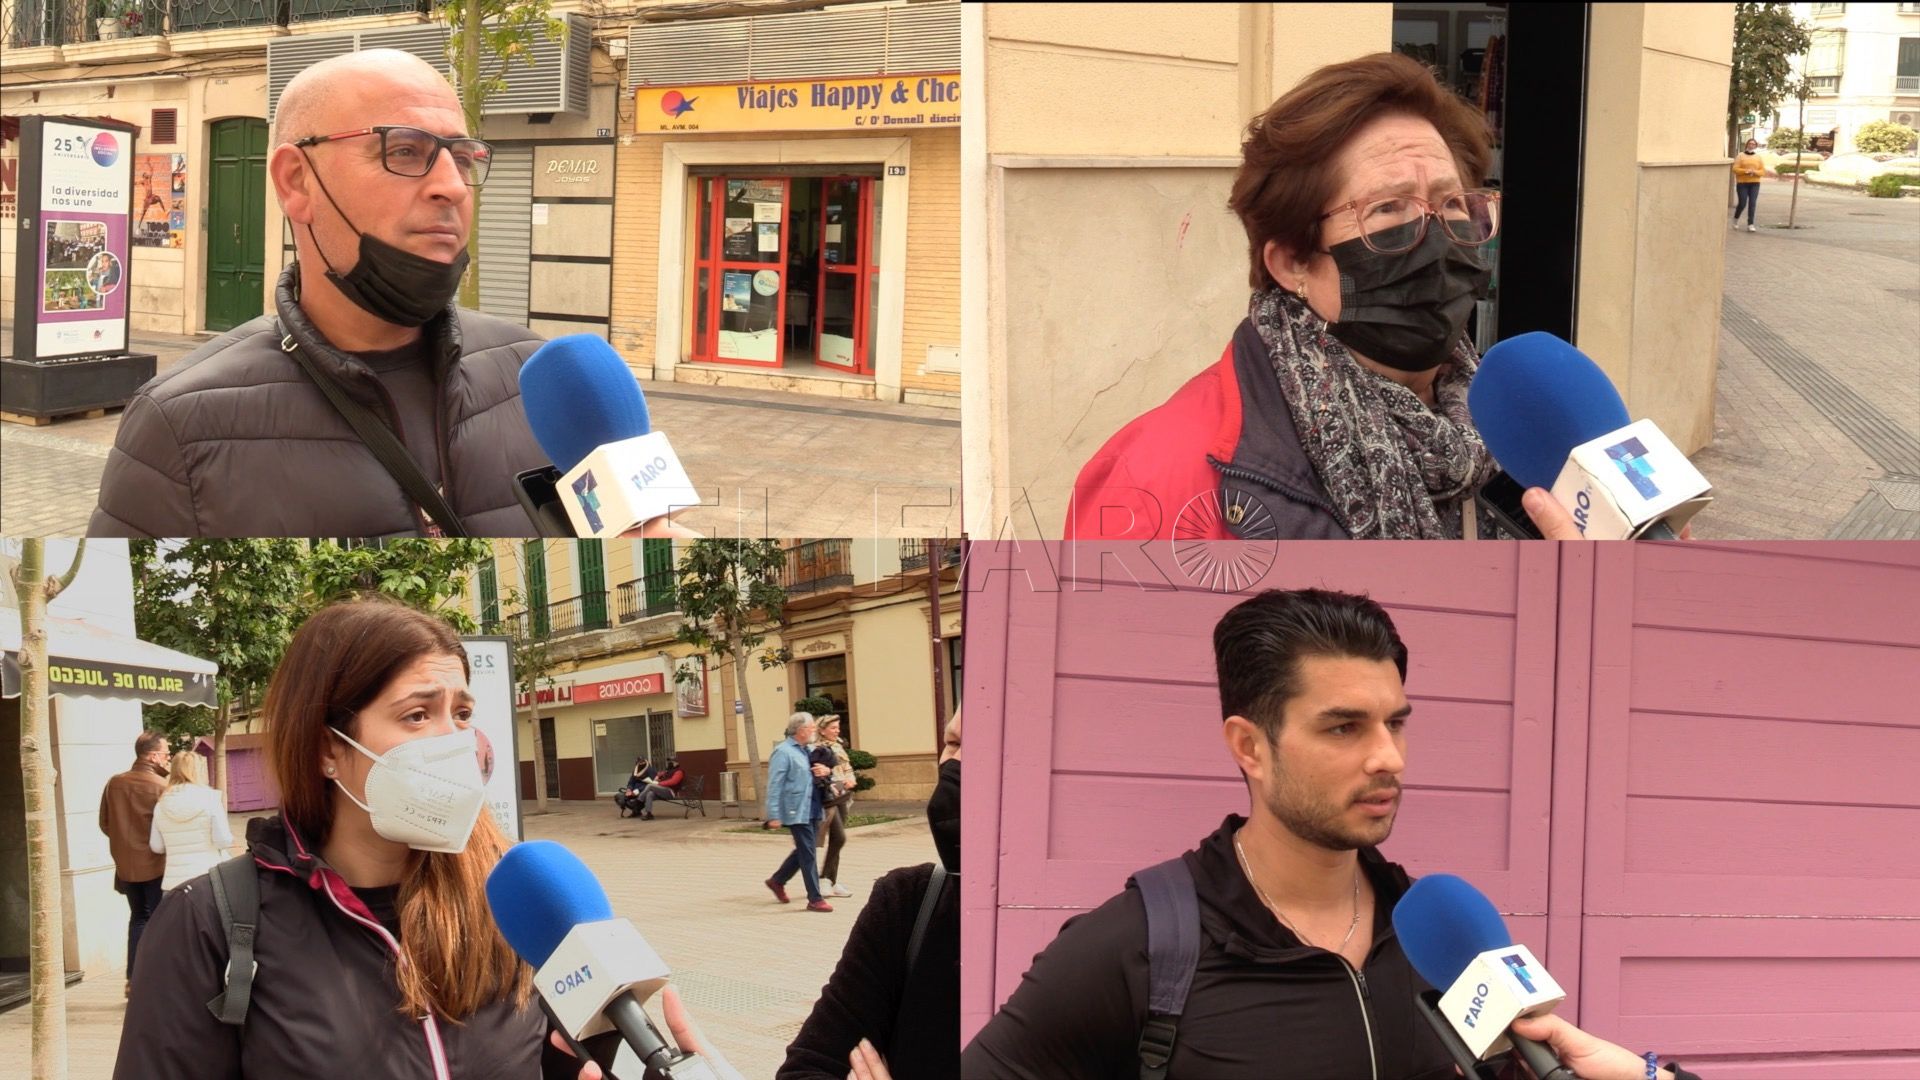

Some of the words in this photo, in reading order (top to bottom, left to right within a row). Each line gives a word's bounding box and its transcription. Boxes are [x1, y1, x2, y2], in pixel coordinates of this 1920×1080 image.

[737, 86, 798, 112] Viajes
[811, 81, 883, 110] Happy
[891, 80, 909, 103] &
[883, 114, 924, 124] Donnell
[54, 138, 72, 152] 25
[52, 186, 62, 194] la
[65, 186, 119, 198] diversidad
[1464, 984, 1488, 1028] FARO
